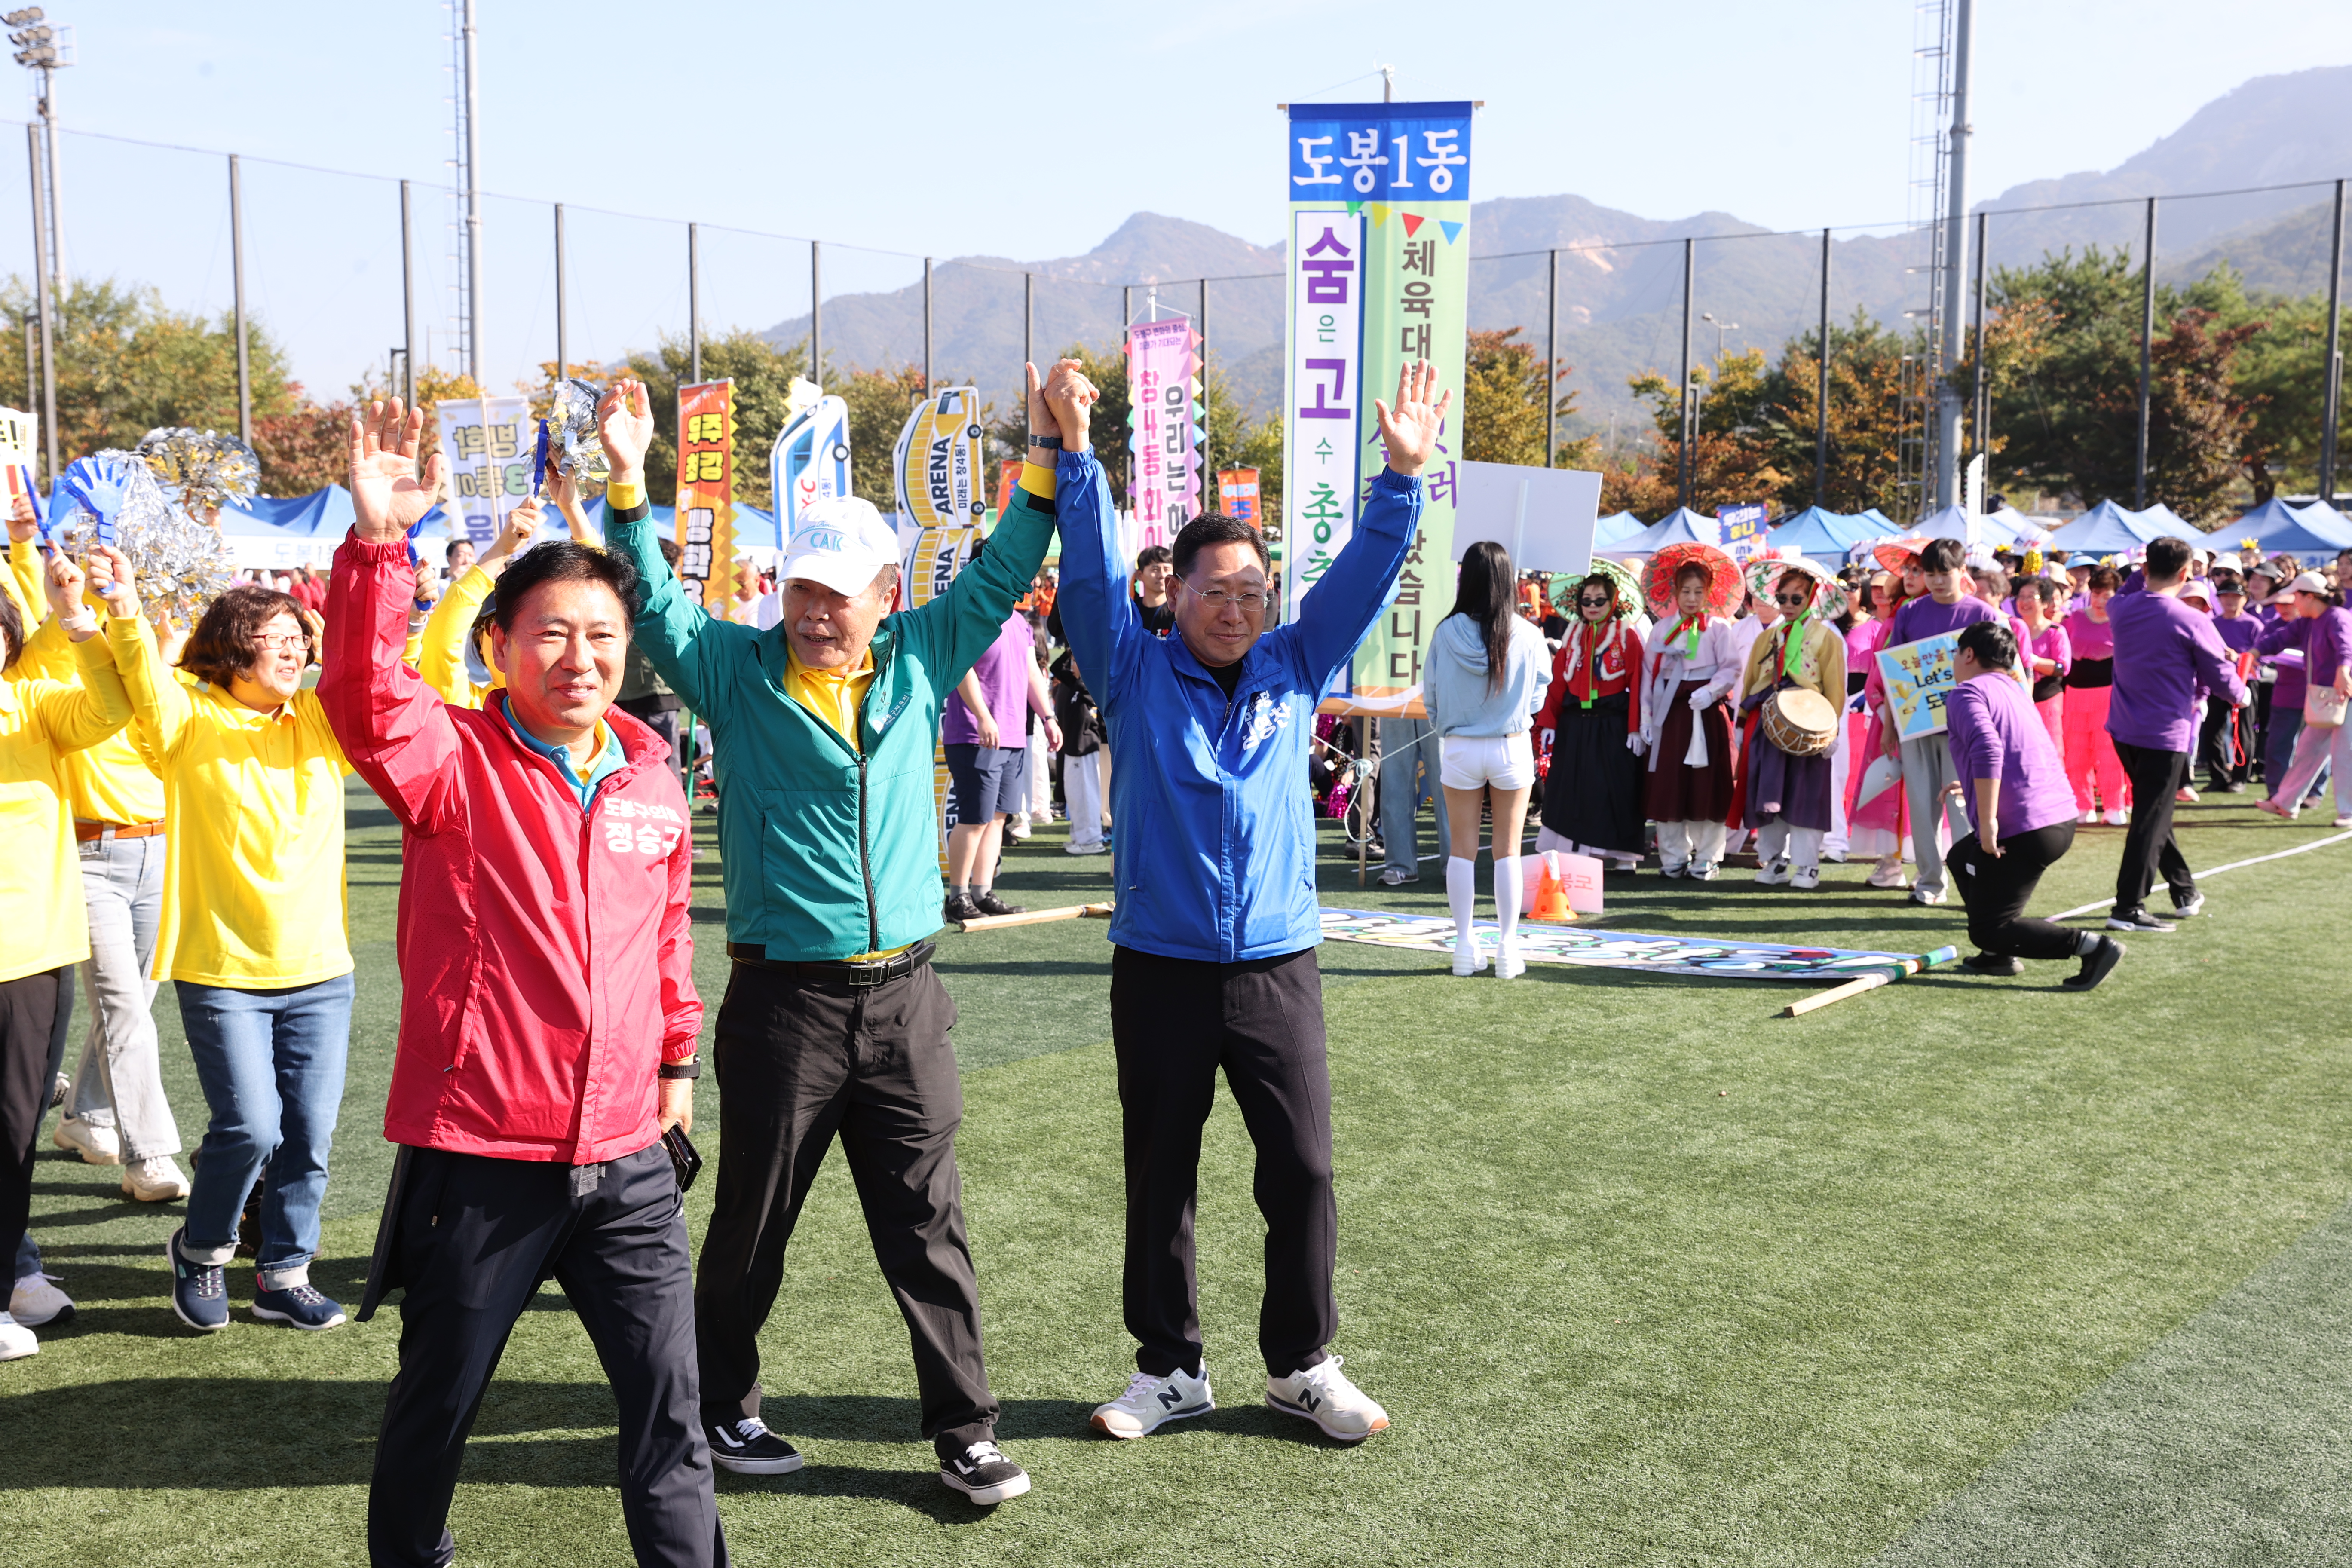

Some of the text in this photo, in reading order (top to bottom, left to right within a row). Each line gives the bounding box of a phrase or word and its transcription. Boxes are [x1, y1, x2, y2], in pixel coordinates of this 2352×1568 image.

[1292, 128, 1467, 193] 도봉1동
[687, 413, 723, 445] 우주
[1140, 370, 1161, 477] 창4동
[1165, 385, 1186, 492] 우리는
[685, 450, 723, 484] 최강
[929, 437, 954, 516] ARENA
[955, 444, 968, 508] 미래는 창4동!
[1723, 506, 1762, 527] 우리는
[1730, 520, 1756, 540] 하나
[810, 532, 844, 551] CAK
[1914, 668, 1953, 688] Let's
[605, 822, 683, 857] 정승구
[1155, 1384, 1183, 1412] N
[1297, 1387, 1322, 1414] N
